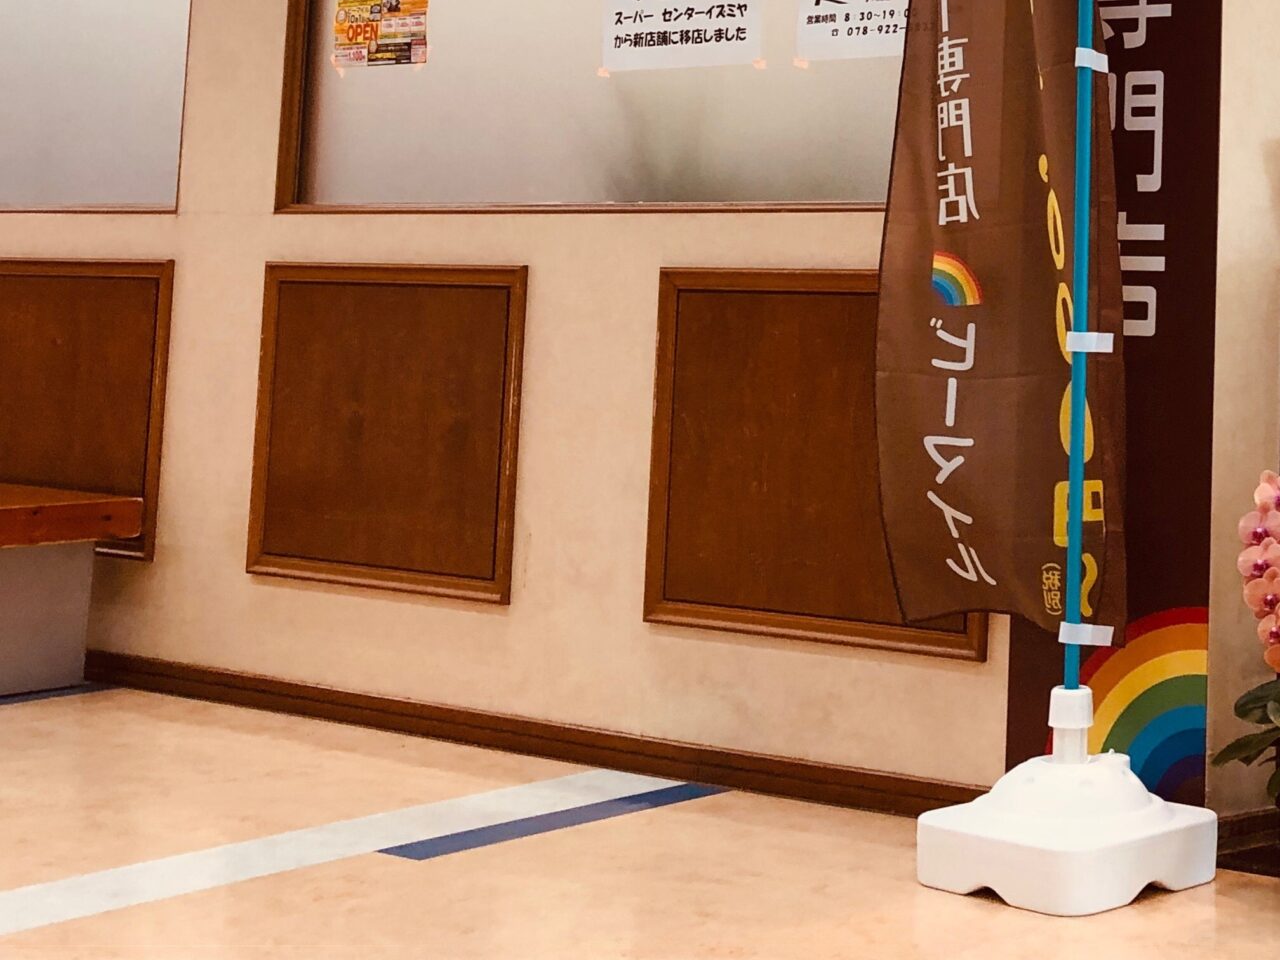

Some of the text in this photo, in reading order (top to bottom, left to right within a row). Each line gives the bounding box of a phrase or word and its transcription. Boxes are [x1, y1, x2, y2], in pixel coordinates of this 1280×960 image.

[614, 10, 654, 25] スーパー
[806, 13, 837, 25] 営業時間
[347, 23, 378, 42] OPEN
[614, 27, 747, 48] から新店舗に移店しました
